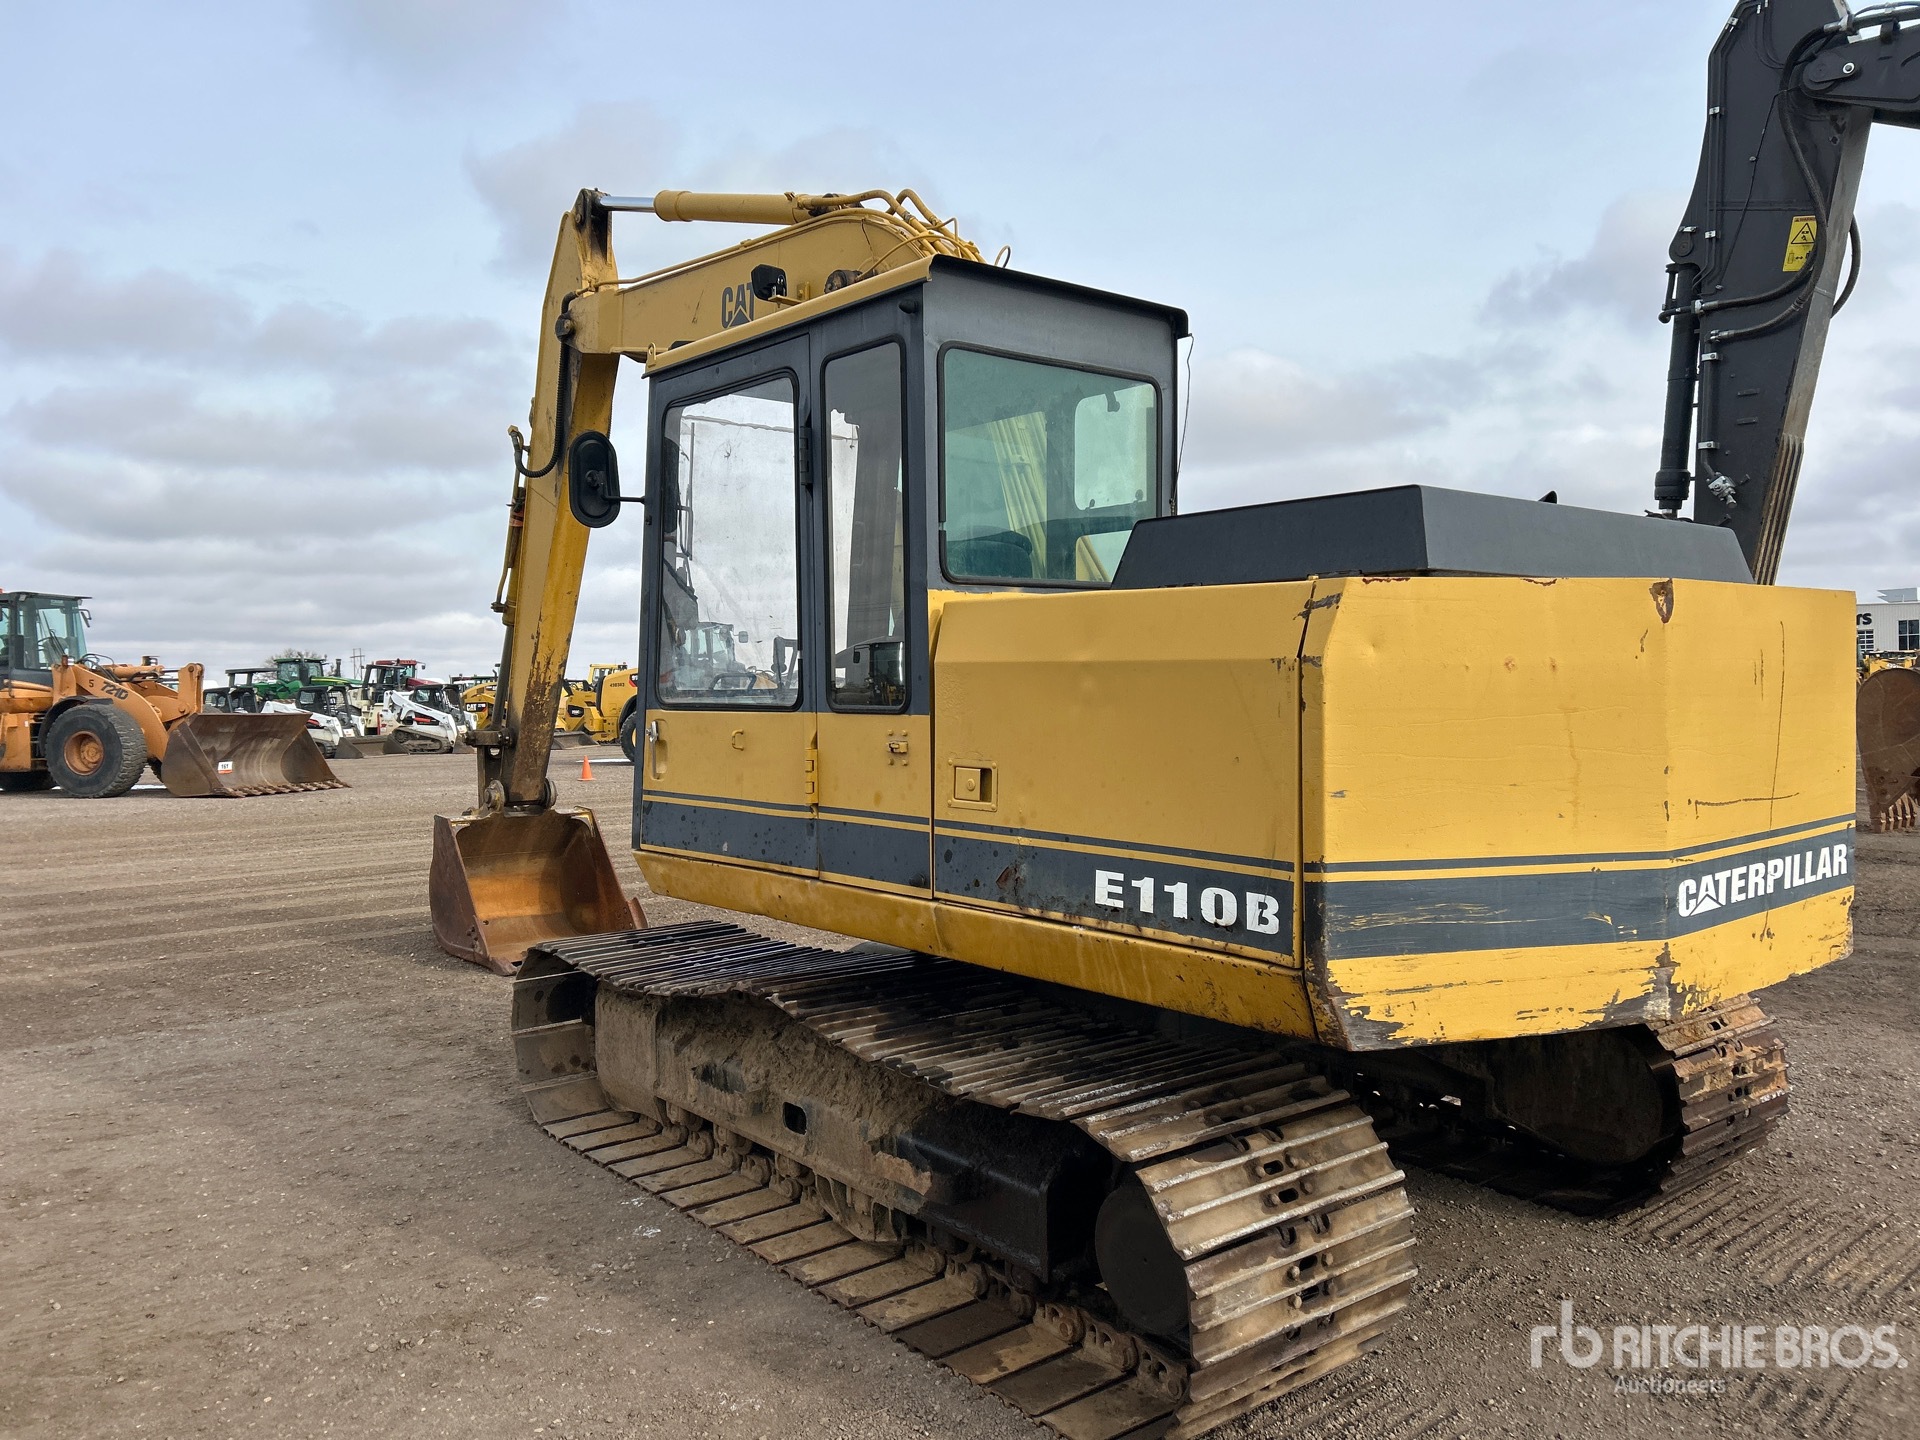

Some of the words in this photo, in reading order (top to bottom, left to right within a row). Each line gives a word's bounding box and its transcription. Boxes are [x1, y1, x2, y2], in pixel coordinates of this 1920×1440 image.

[721, 281, 755, 329] CAT
[101, 680, 129, 701] 721D
[466, 703, 477, 712] CAT
[1094, 869, 1280, 935] E110B
[1678, 843, 1848, 918] CATERPILLAR
